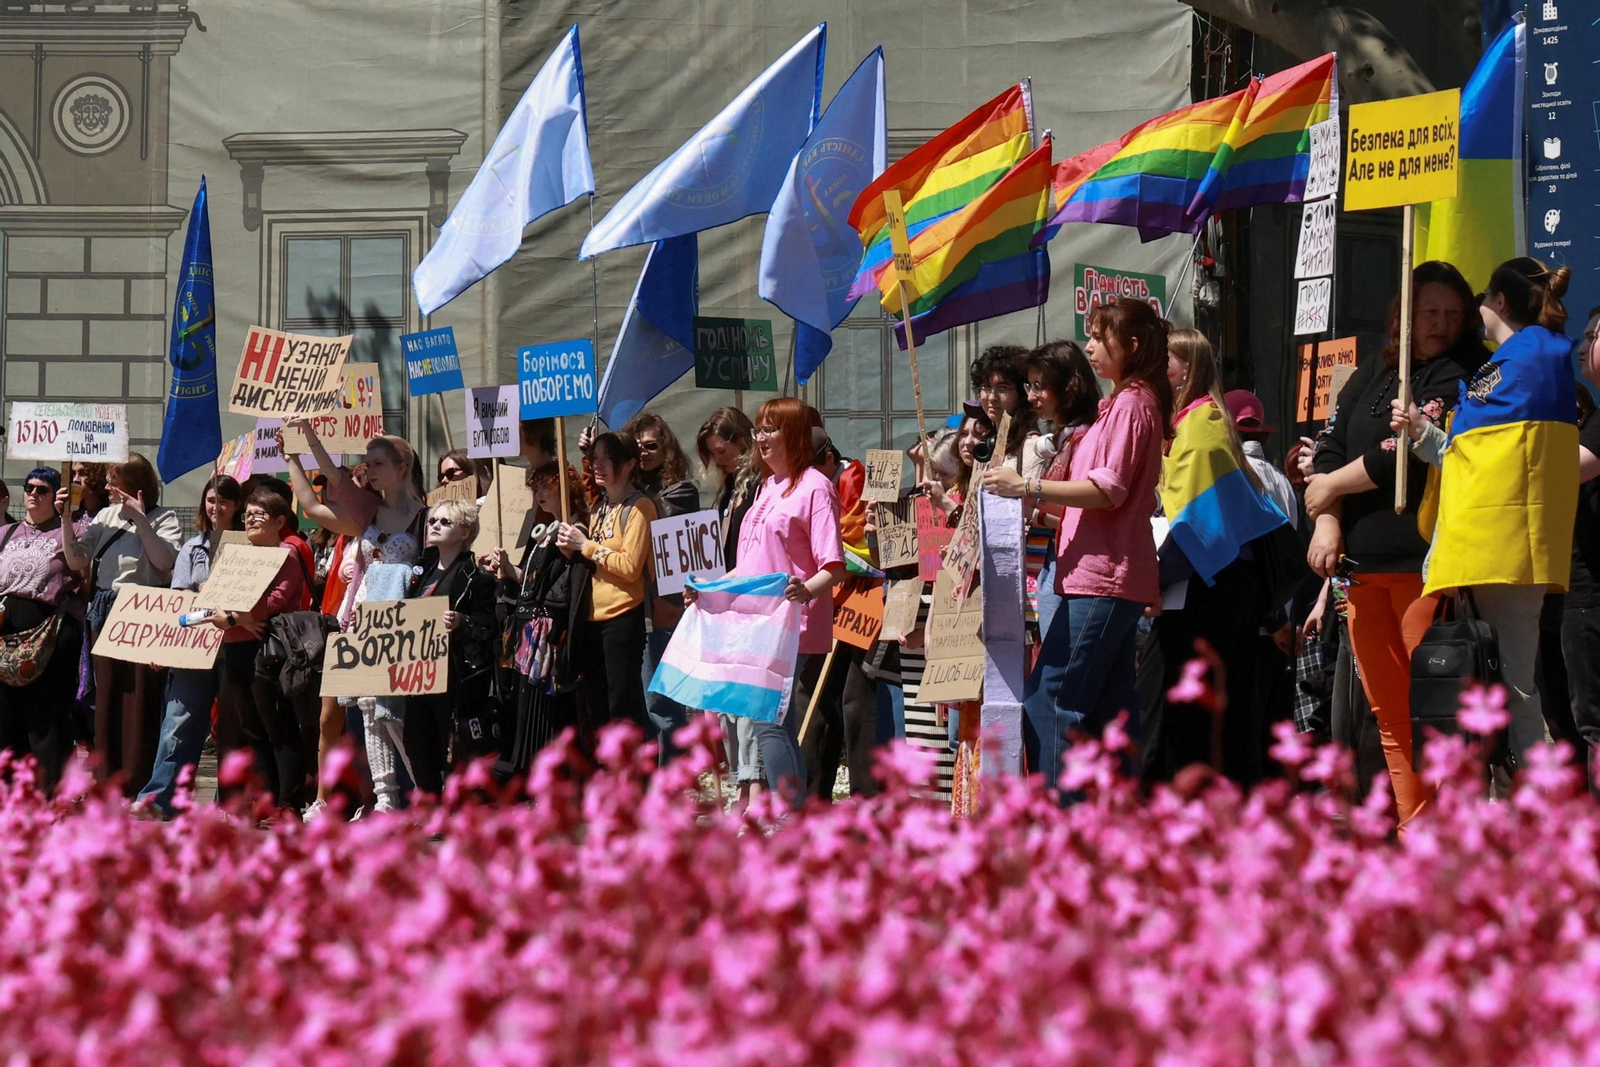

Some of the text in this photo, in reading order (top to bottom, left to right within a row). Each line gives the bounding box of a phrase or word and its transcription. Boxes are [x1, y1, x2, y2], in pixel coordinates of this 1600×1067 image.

[1542, 36, 1558, 45] 1425
[1548, 112, 1556, 120] 12
[1350, 116, 1455, 153] Безпека для всіх.
[1348, 144, 1455, 181] Але не для мене?
[1548, 185, 1556, 193] 20
[1300, 280, 1329, 305] ПРОТИ
[283, 340, 346, 366] УЗАКО-
[407, 334, 451, 352] НАС БАГАТО
[240, 332, 285, 383] НІ
[717, 355, 771, 383] СПИНУ
[175, 383, 207, 395] FIGHT
[274, 366, 329, 391] НЕНІЙ
[522, 373, 593, 405] ПОБОРЕМО
[474, 398, 479, 420] Я
[16, 420, 59, 444] 15150
[68, 419, 115, 434] ПОЛЮВАННЯ
[85, 433, 94, 442] НА
[257, 429, 262, 440] Я
[344, 414, 361, 437] NO
[473, 427, 509, 447] БУТИ СОБОЮ
[66, 442, 107, 455] ВІДЬОМ!!!
[255, 446, 278, 459] Я МАЮ
[221, 550, 250, 567] When
[653, 519, 723, 578] НЕ БІЙСЯ
[120, 592, 184, 613] МАЮ
[358, 601, 406, 641] just
[108, 620, 225, 656] ОДРУЖИТИСЯ
[419, 619, 447, 661] this
[388, 660, 437, 693] WAY
